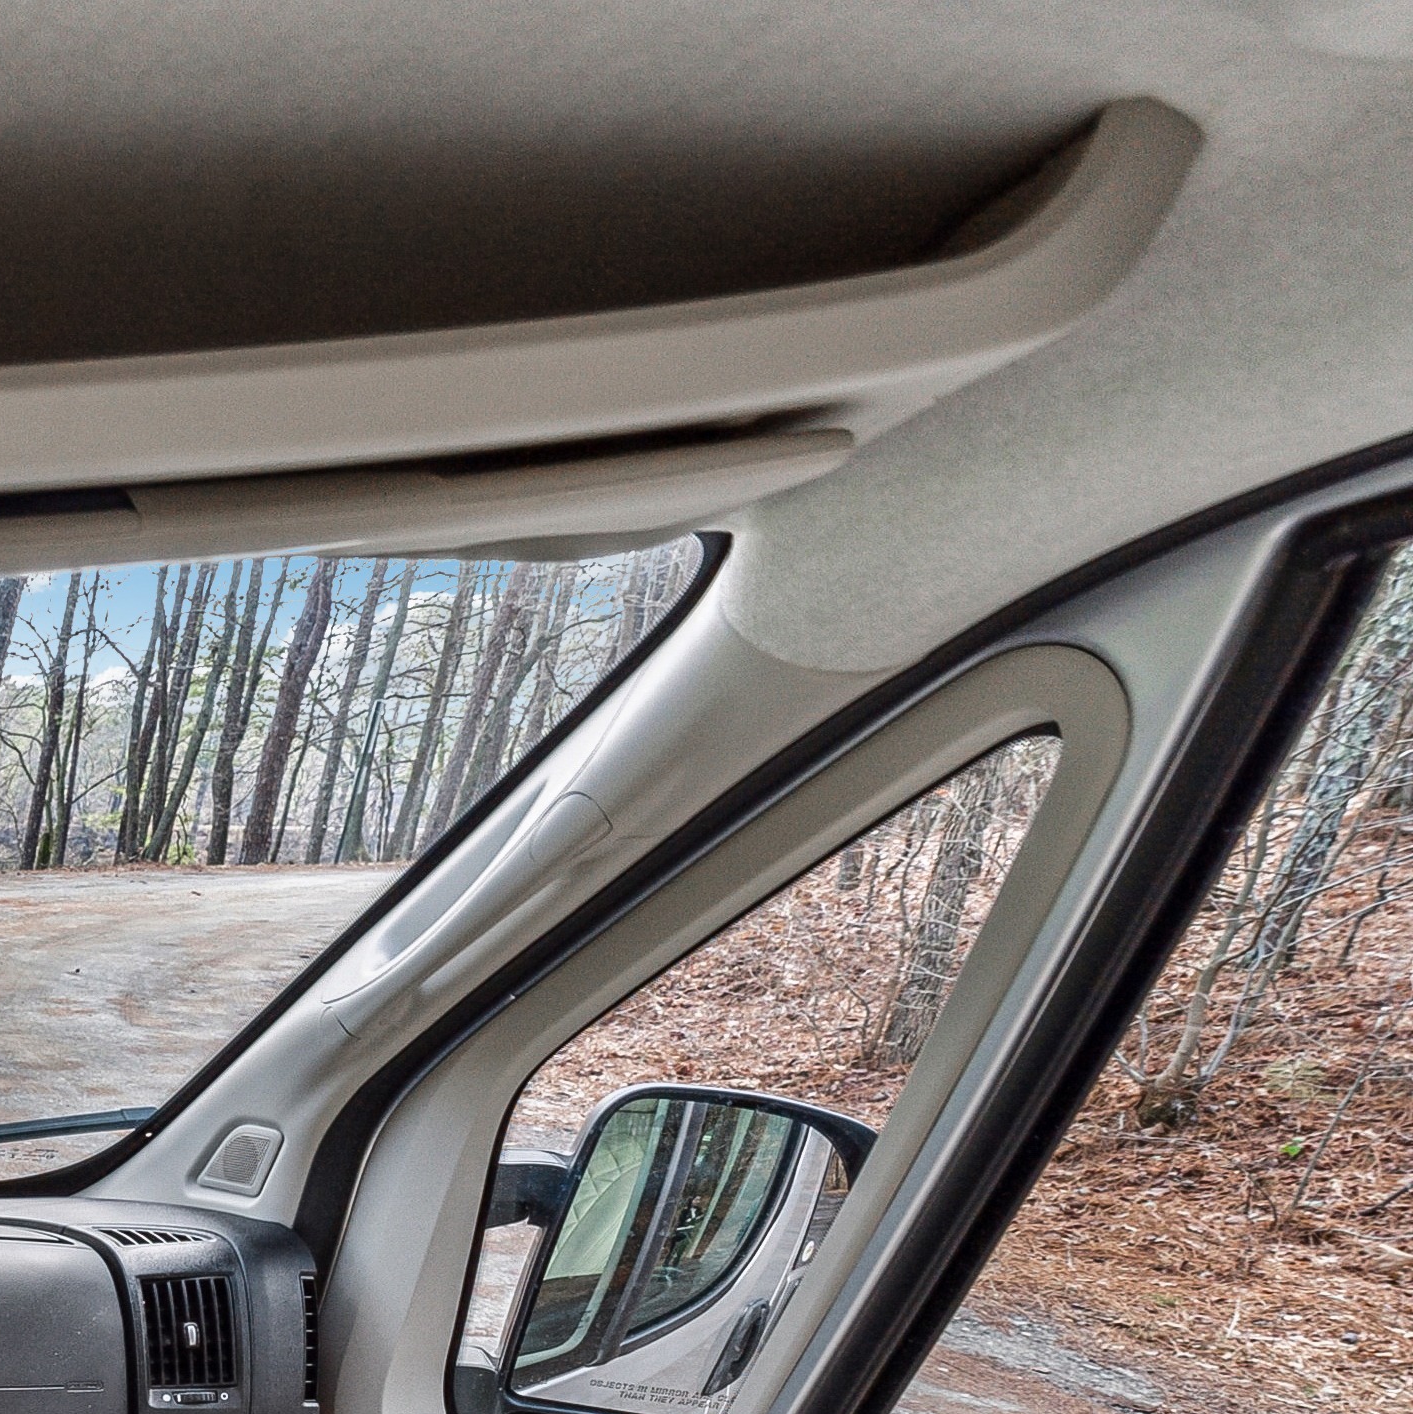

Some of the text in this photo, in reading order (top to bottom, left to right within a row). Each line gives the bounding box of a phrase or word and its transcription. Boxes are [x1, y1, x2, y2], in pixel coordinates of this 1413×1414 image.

[589, 1378, 636, 1392] OBJECTS
[650, 1386, 690, 1398] MIRROR
[619, 1390, 646, 1402] THAN
